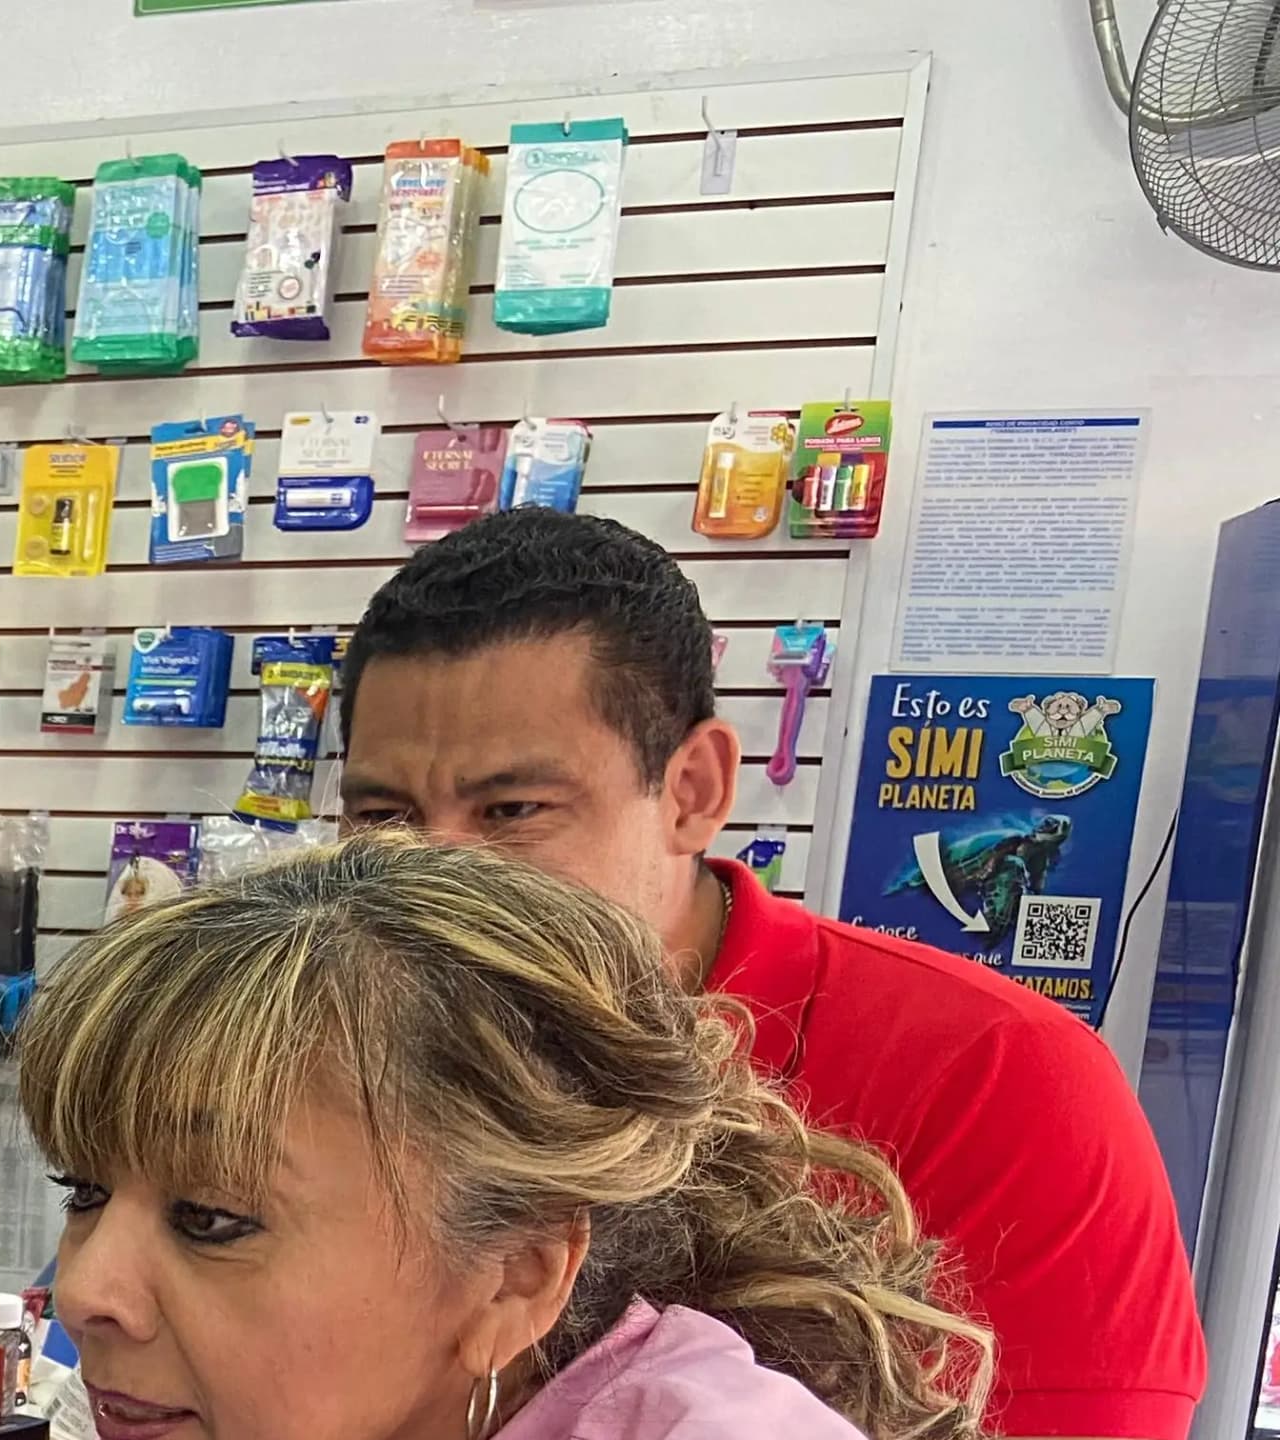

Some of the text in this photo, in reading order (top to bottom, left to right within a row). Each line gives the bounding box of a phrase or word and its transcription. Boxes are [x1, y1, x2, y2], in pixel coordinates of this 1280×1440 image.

[423, 450, 474, 461] ETERNAL
[425, 461, 474, 471] SECRET
[891, 683, 992, 719] Esto es
[886, 722, 984, 779] SÍMI
[1022, 747, 1095, 763] PLANETA
[878, 783, 976, 810] PLANETA
